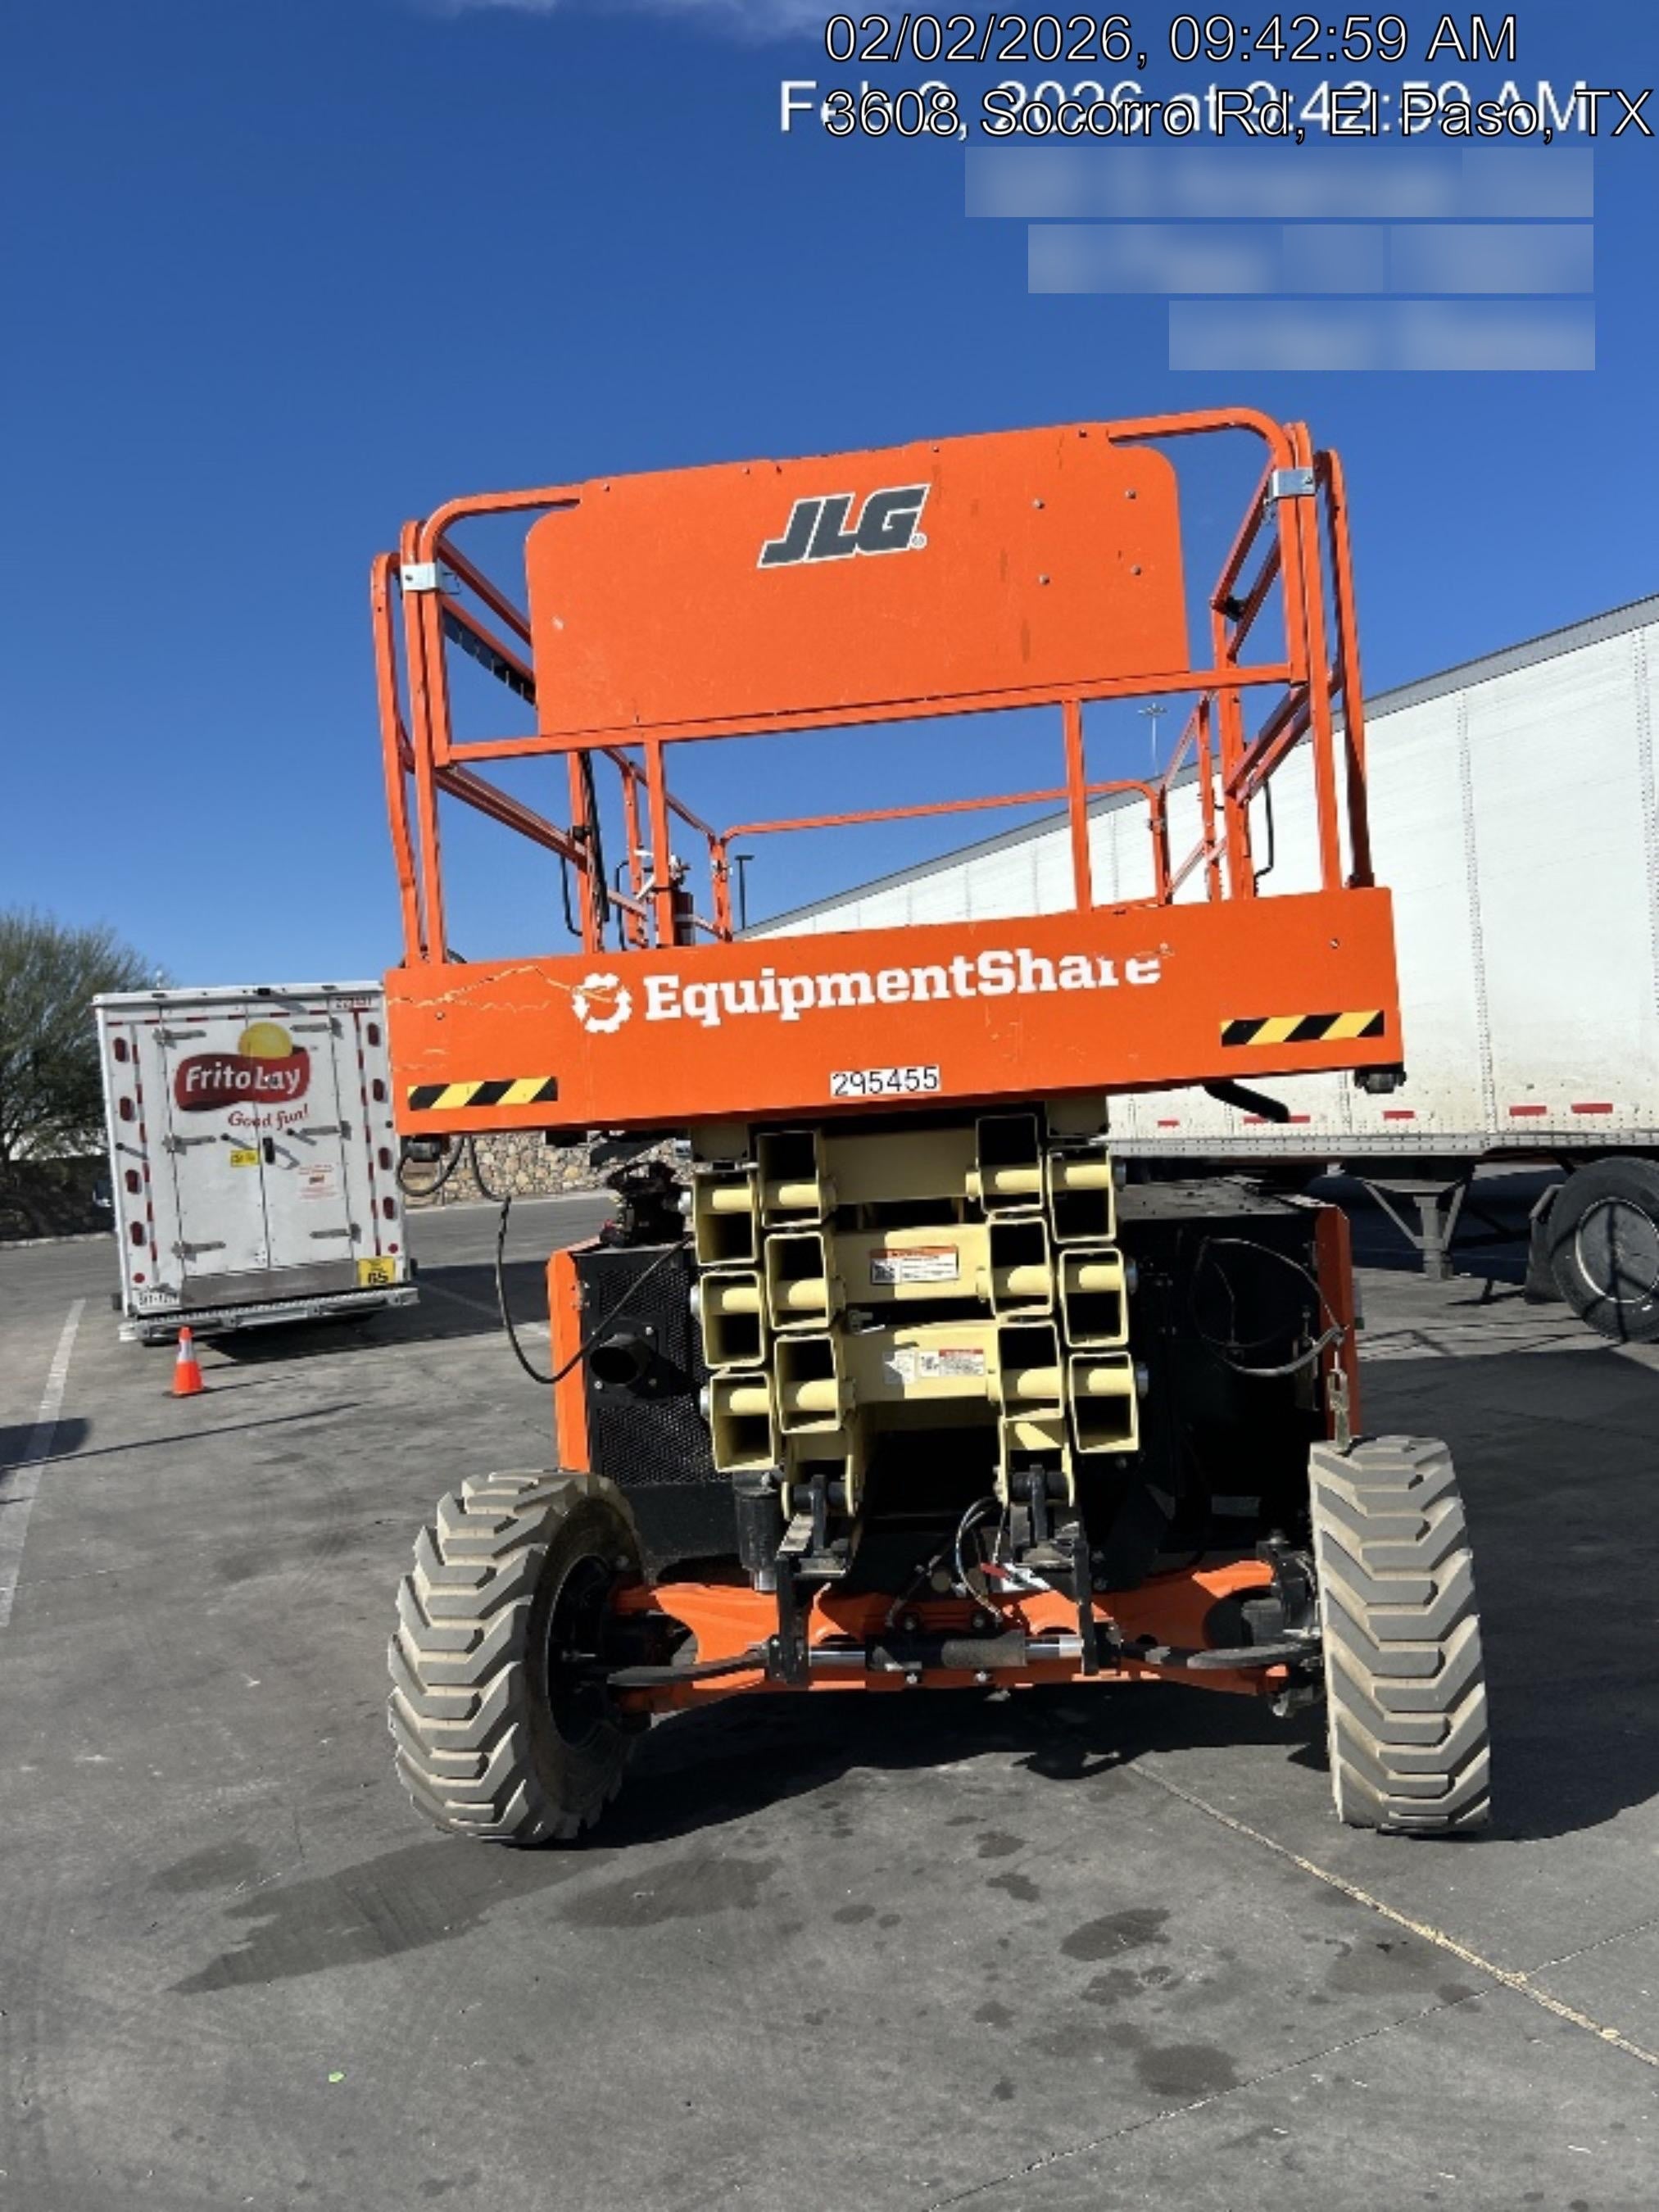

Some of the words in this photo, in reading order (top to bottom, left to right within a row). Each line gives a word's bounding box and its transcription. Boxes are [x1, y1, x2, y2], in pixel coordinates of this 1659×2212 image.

[757, 483, 930, 569] JLG
[643, 948, 1161, 1027] EquipmentShare
[832, 1067, 939, 1096] 295455
